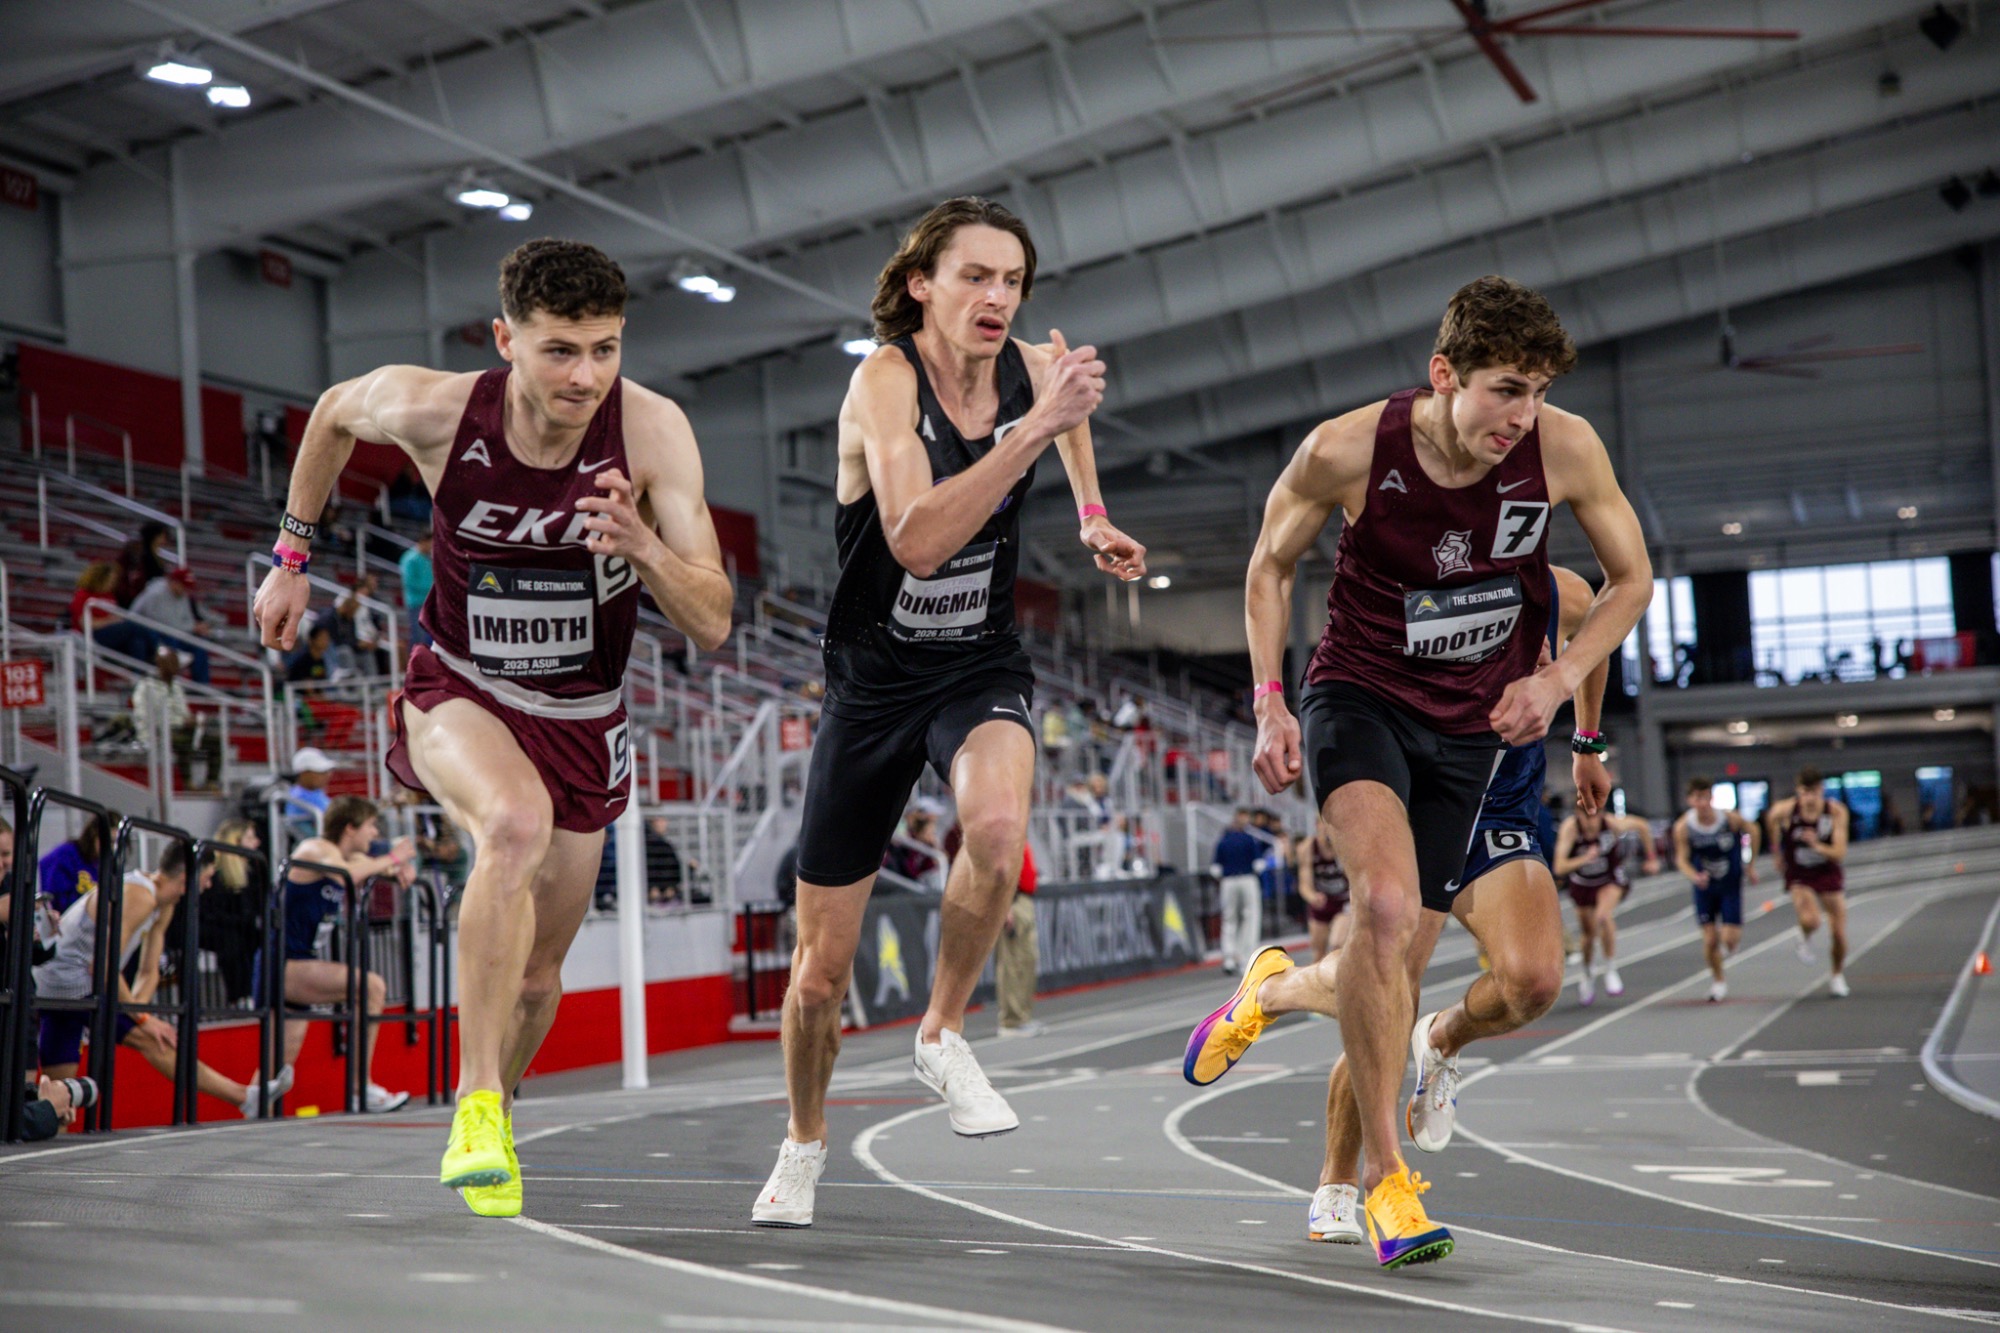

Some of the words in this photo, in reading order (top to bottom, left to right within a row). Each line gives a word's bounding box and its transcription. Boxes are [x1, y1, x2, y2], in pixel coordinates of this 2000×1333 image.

[1503, 505, 1545, 554] 7
[949, 560, 962, 569] THE
[603, 554, 631, 595] 9
[517, 579, 533, 591] THE
[533, 580, 586, 592] DESTINATION.
[1452, 595, 1468, 606] THE
[1468, 587, 1516, 604] DESTINATION.
[473, 614, 587, 644] IMROTH
[914, 629, 938, 638] 2026
[938, 628, 963, 637] ASUN
[1412, 617, 1514, 657] HOOTEN
[503, 660, 529, 670] 2026
[532, 658, 560, 669] ASUN
[6, 664, 37, 684] 103
[6, 685, 38, 703] 104
[614, 732, 628, 781] 9
